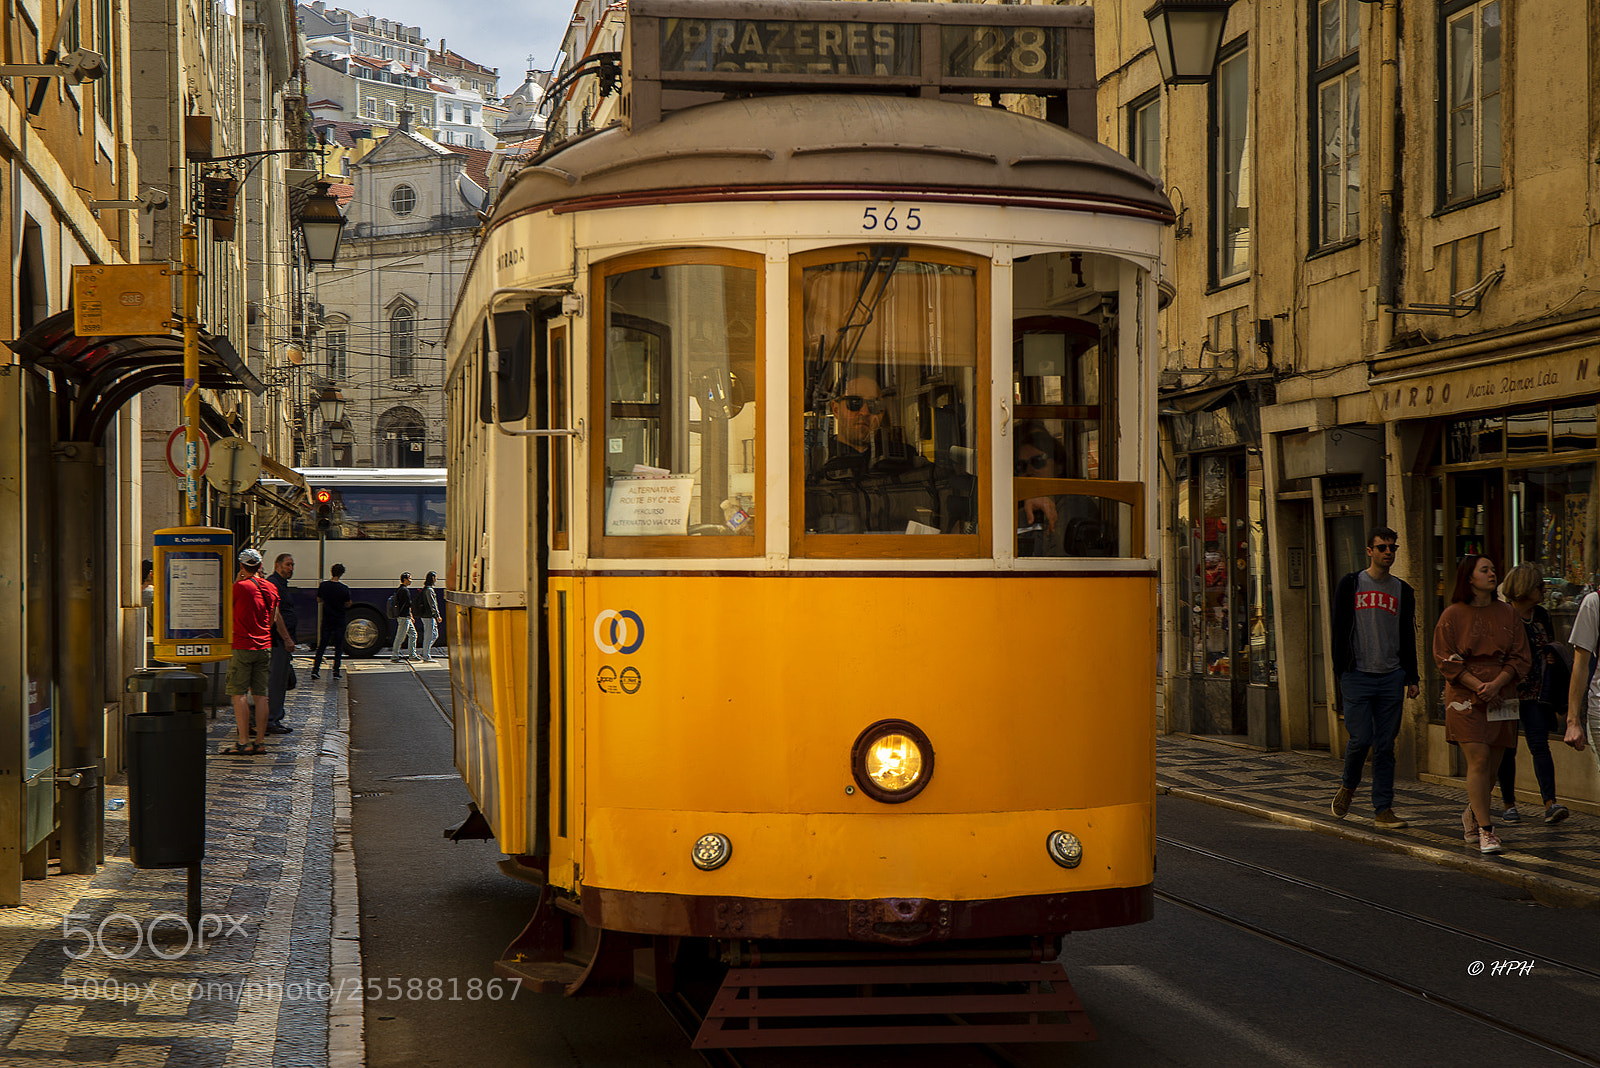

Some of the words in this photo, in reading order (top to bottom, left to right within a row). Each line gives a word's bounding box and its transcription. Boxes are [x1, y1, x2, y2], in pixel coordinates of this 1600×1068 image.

[682, 19, 896, 57] PRAZERES
[973, 25, 1048, 75] 28
[862, 206, 922, 231] 565
[619, 497, 645, 505] ROUTE
[628, 486, 676, 494] ALTERNATIVE
[1356, 592, 1397, 613] KILL
